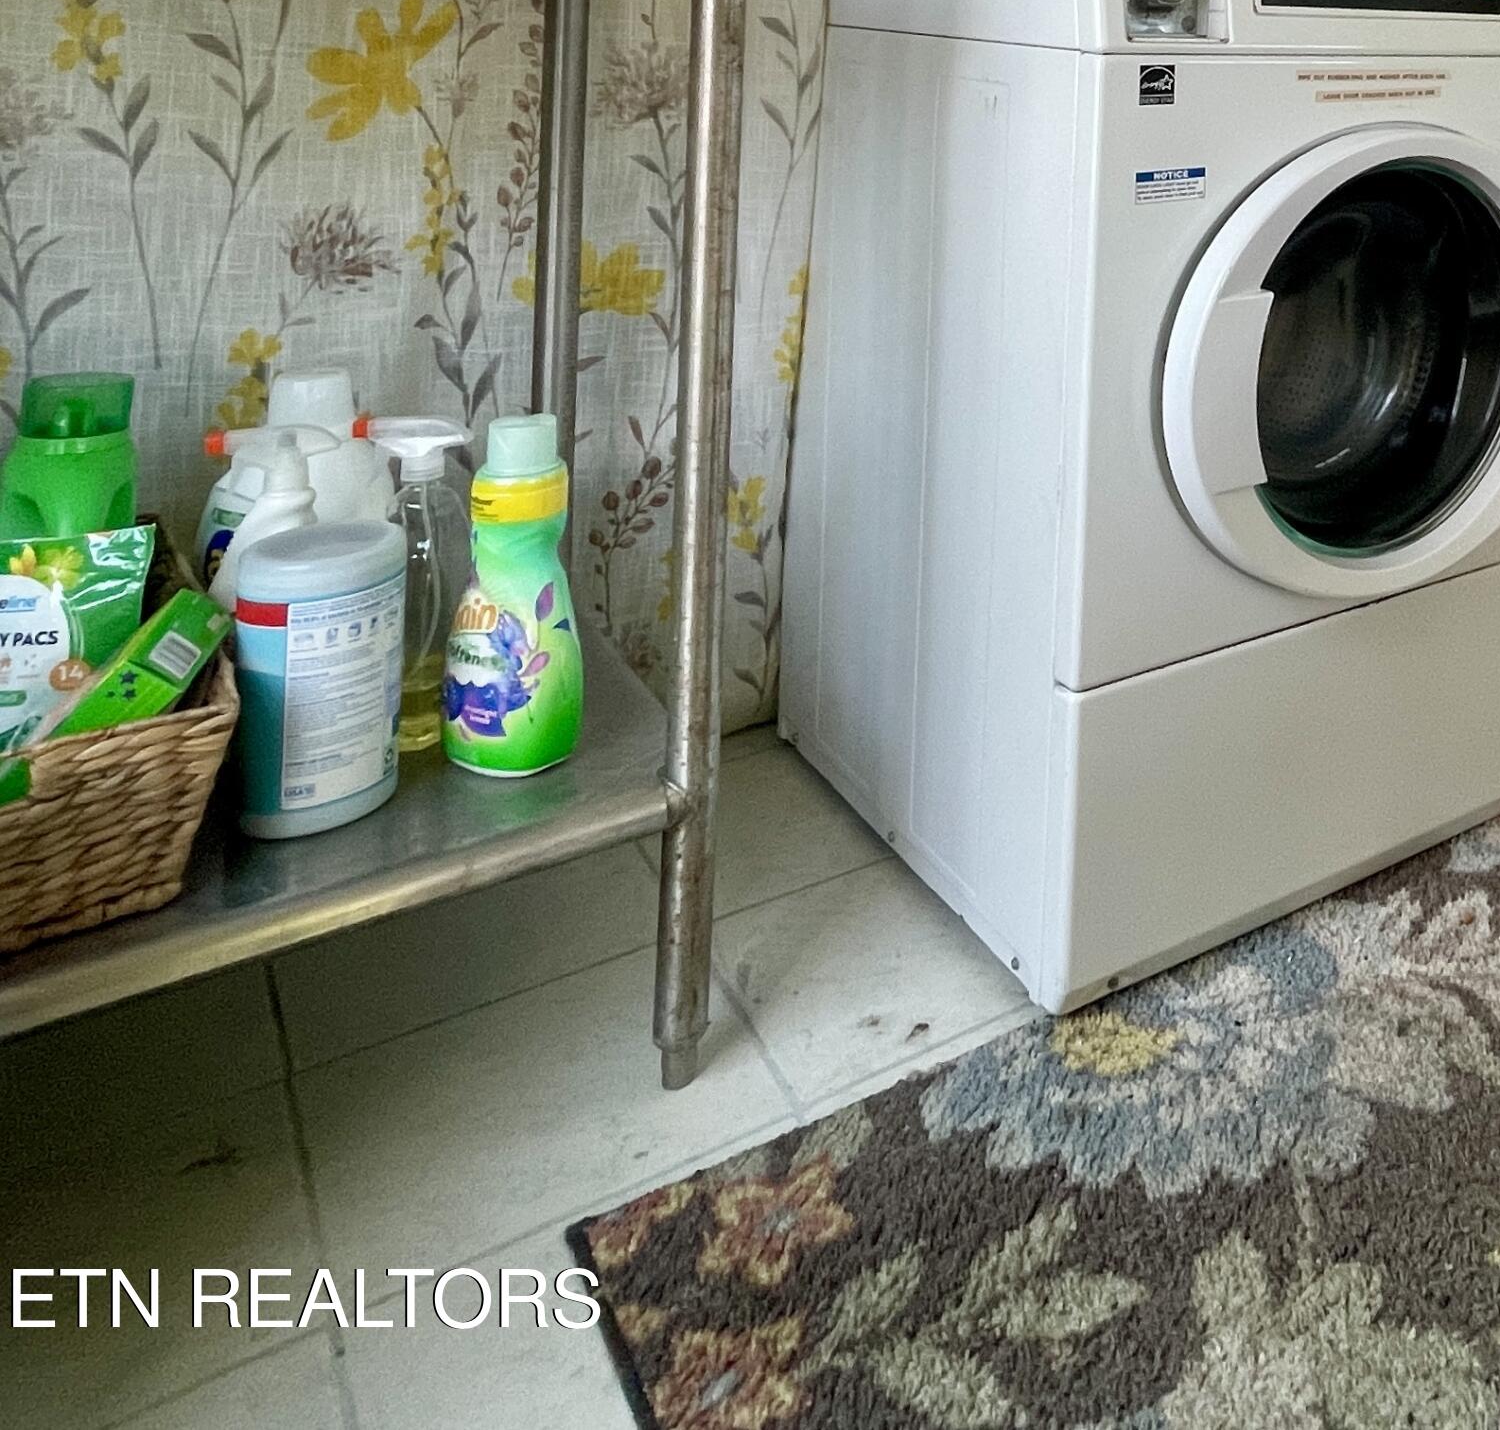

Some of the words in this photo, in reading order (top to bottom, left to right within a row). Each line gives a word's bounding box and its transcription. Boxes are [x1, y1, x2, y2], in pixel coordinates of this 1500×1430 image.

[1153, 169, 1189, 180] NOTICE
[12, 630, 59, 647] PACS
[58, 665, 85, 682] 14
